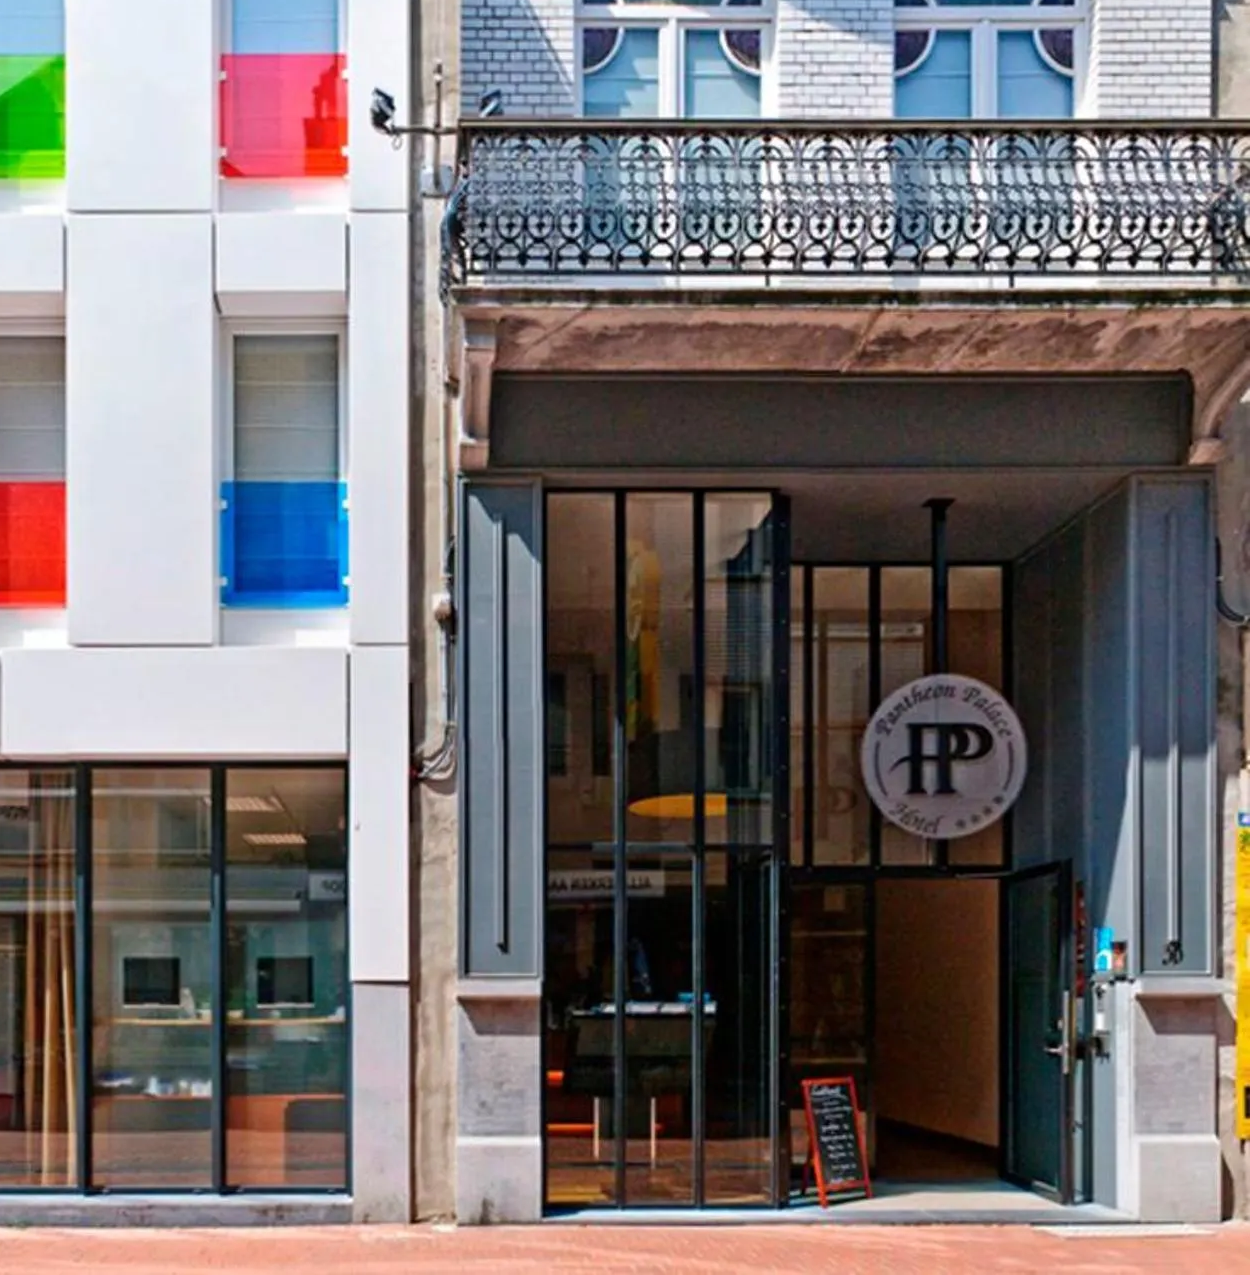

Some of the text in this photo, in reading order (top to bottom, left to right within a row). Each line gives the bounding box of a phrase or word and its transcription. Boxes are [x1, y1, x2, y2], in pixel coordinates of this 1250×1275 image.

[875, 684, 1013, 738] Pantheon Palace
[888, 802, 946, 835] Hotel
